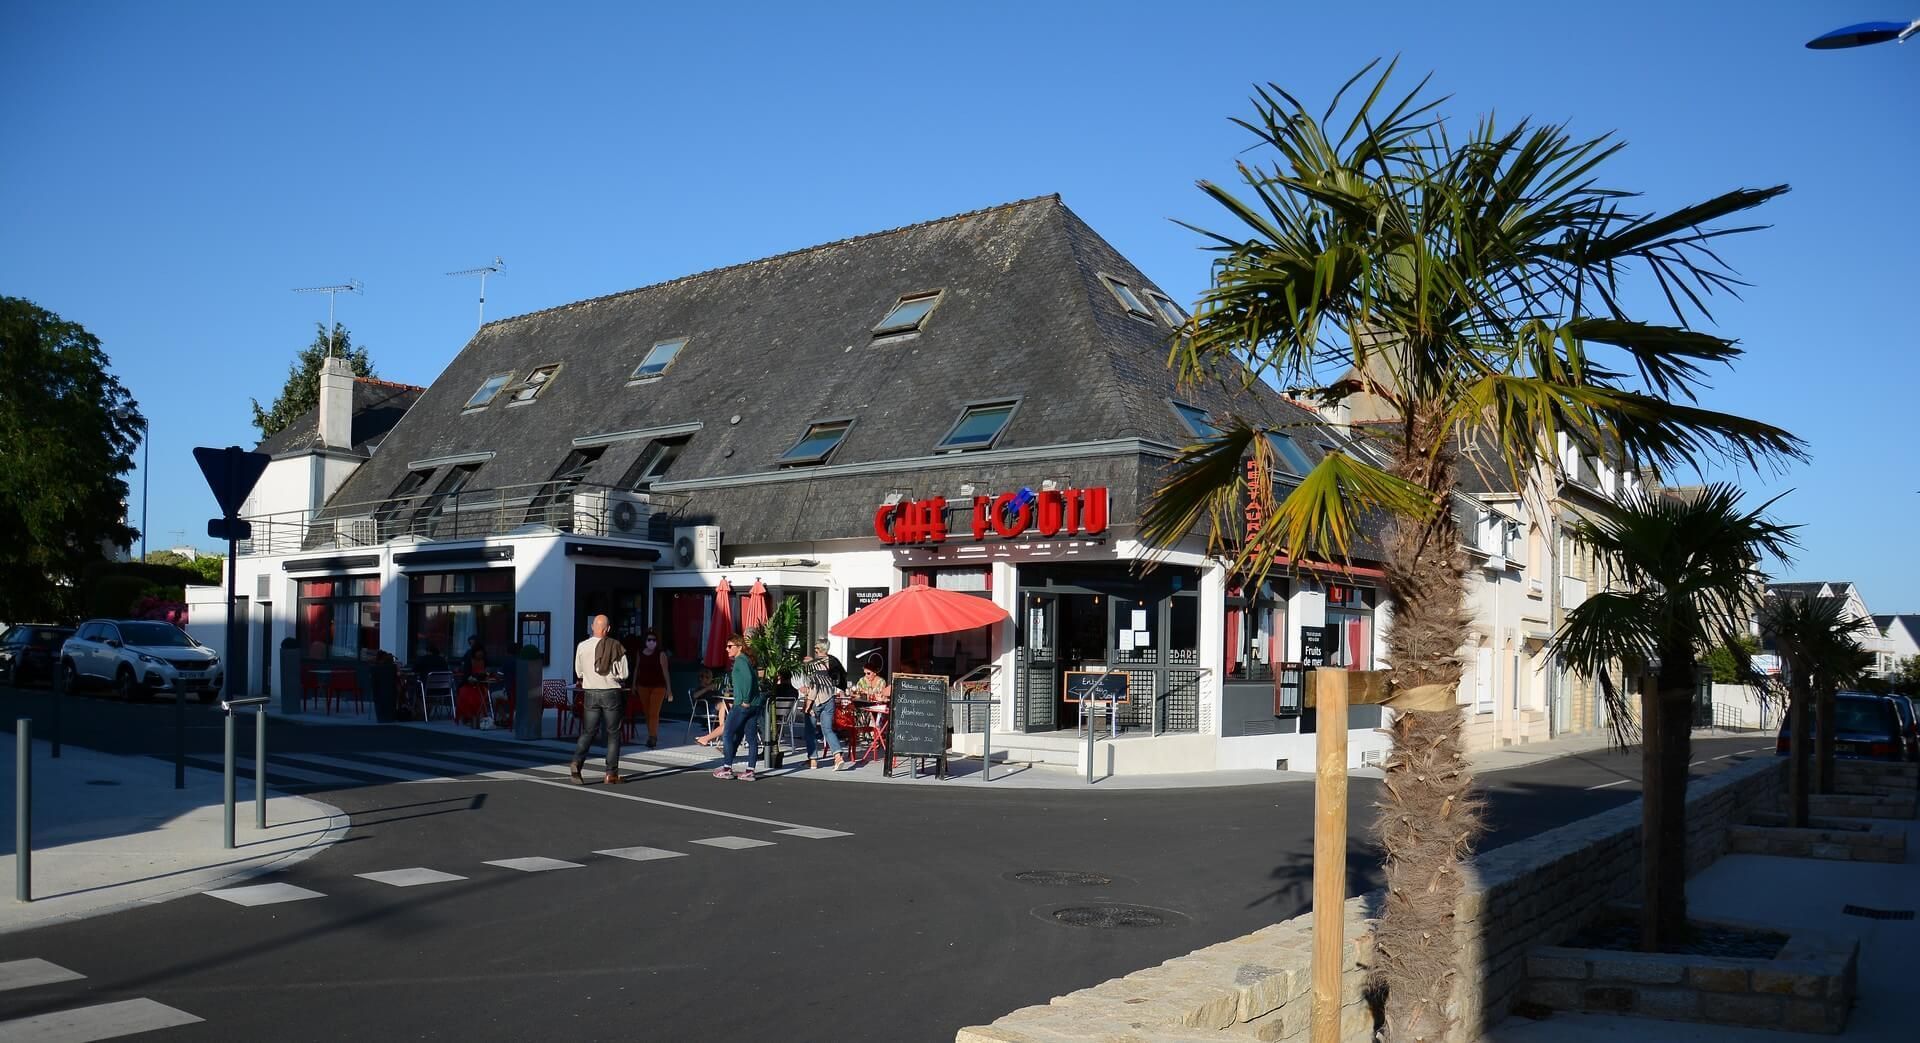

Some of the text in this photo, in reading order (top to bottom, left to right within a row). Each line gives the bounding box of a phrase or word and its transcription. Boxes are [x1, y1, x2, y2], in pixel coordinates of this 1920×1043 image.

[1174, 649, 1192, 659] BAR
[1305, 646, 1322, 656] Fruits
[1303, 656, 1323, 667] de mer
